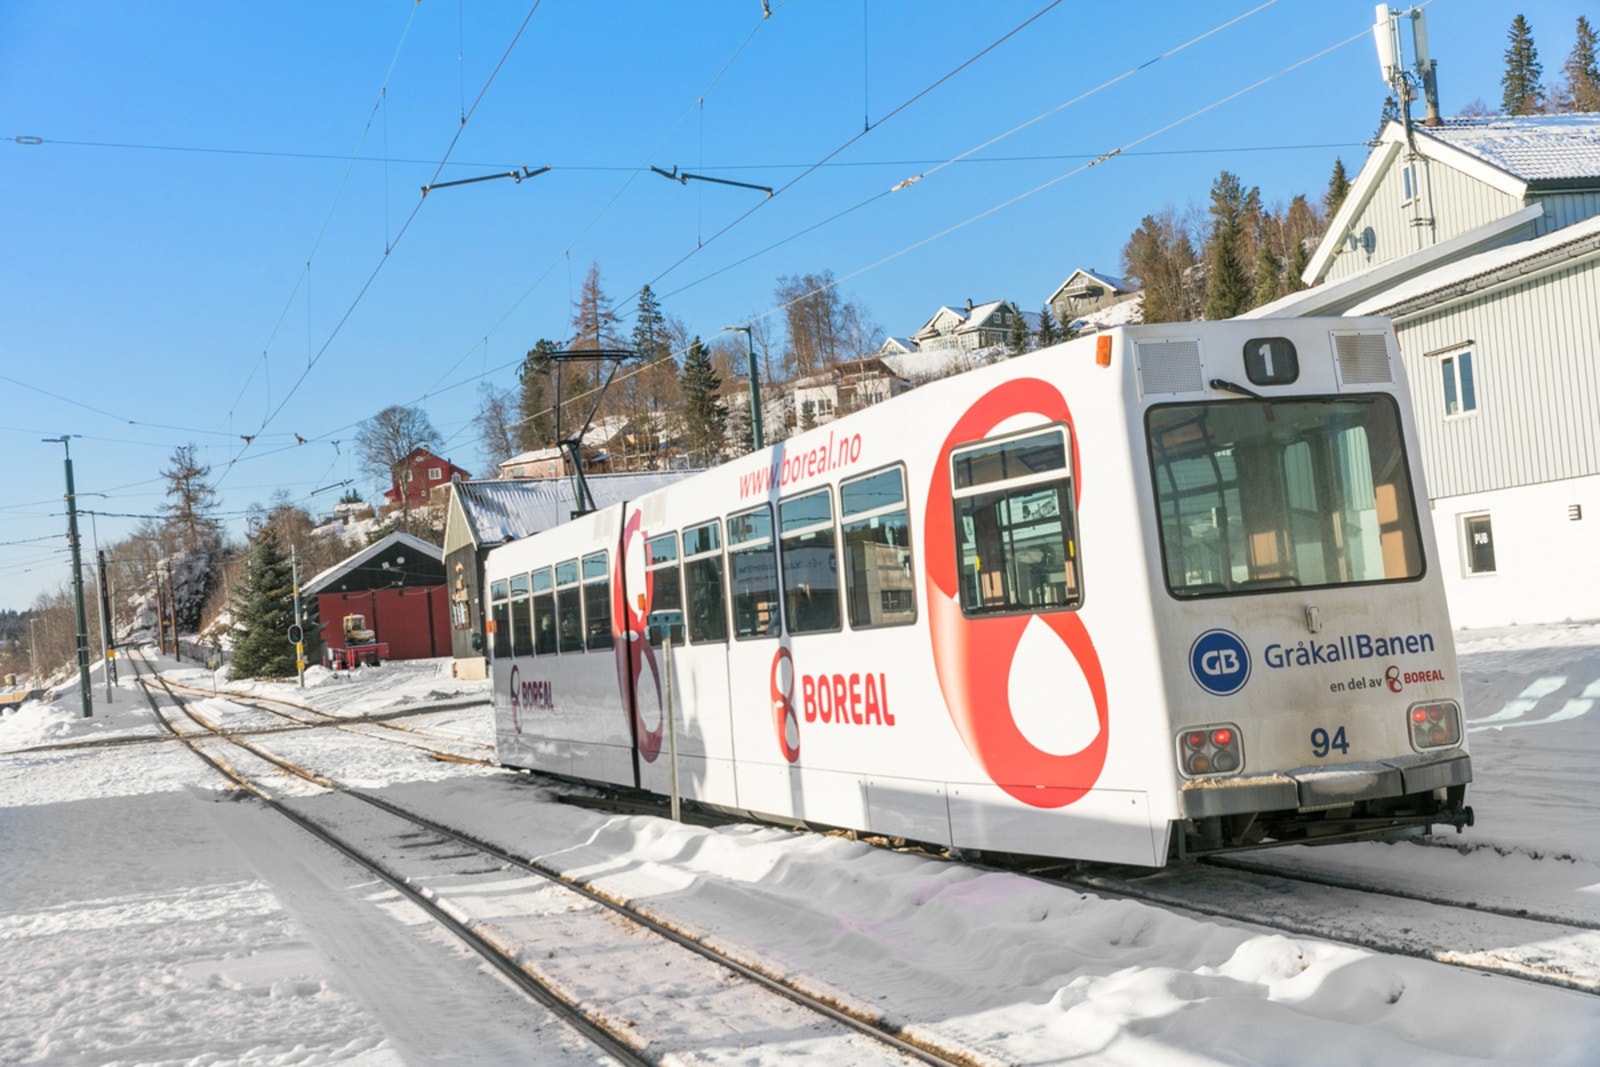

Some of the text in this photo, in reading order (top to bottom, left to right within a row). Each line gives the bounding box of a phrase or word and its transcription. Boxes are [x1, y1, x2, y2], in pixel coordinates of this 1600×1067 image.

[1259, 344, 1274, 376] 1
[740, 430, 862, 499] www.boreal.no
[1474, 533, 1489, 544] PUB
[1201, 649, 1240, 676] GB
[1264, 633, 1435, 668] GråkallBanen
[522, 681, 554, 711] BOREAL
[1330, 669, 1445, 692] en del av BOREAL
[802, 673, 895, 726] BOREAL
[1310, 726, 1349, 758] 94
